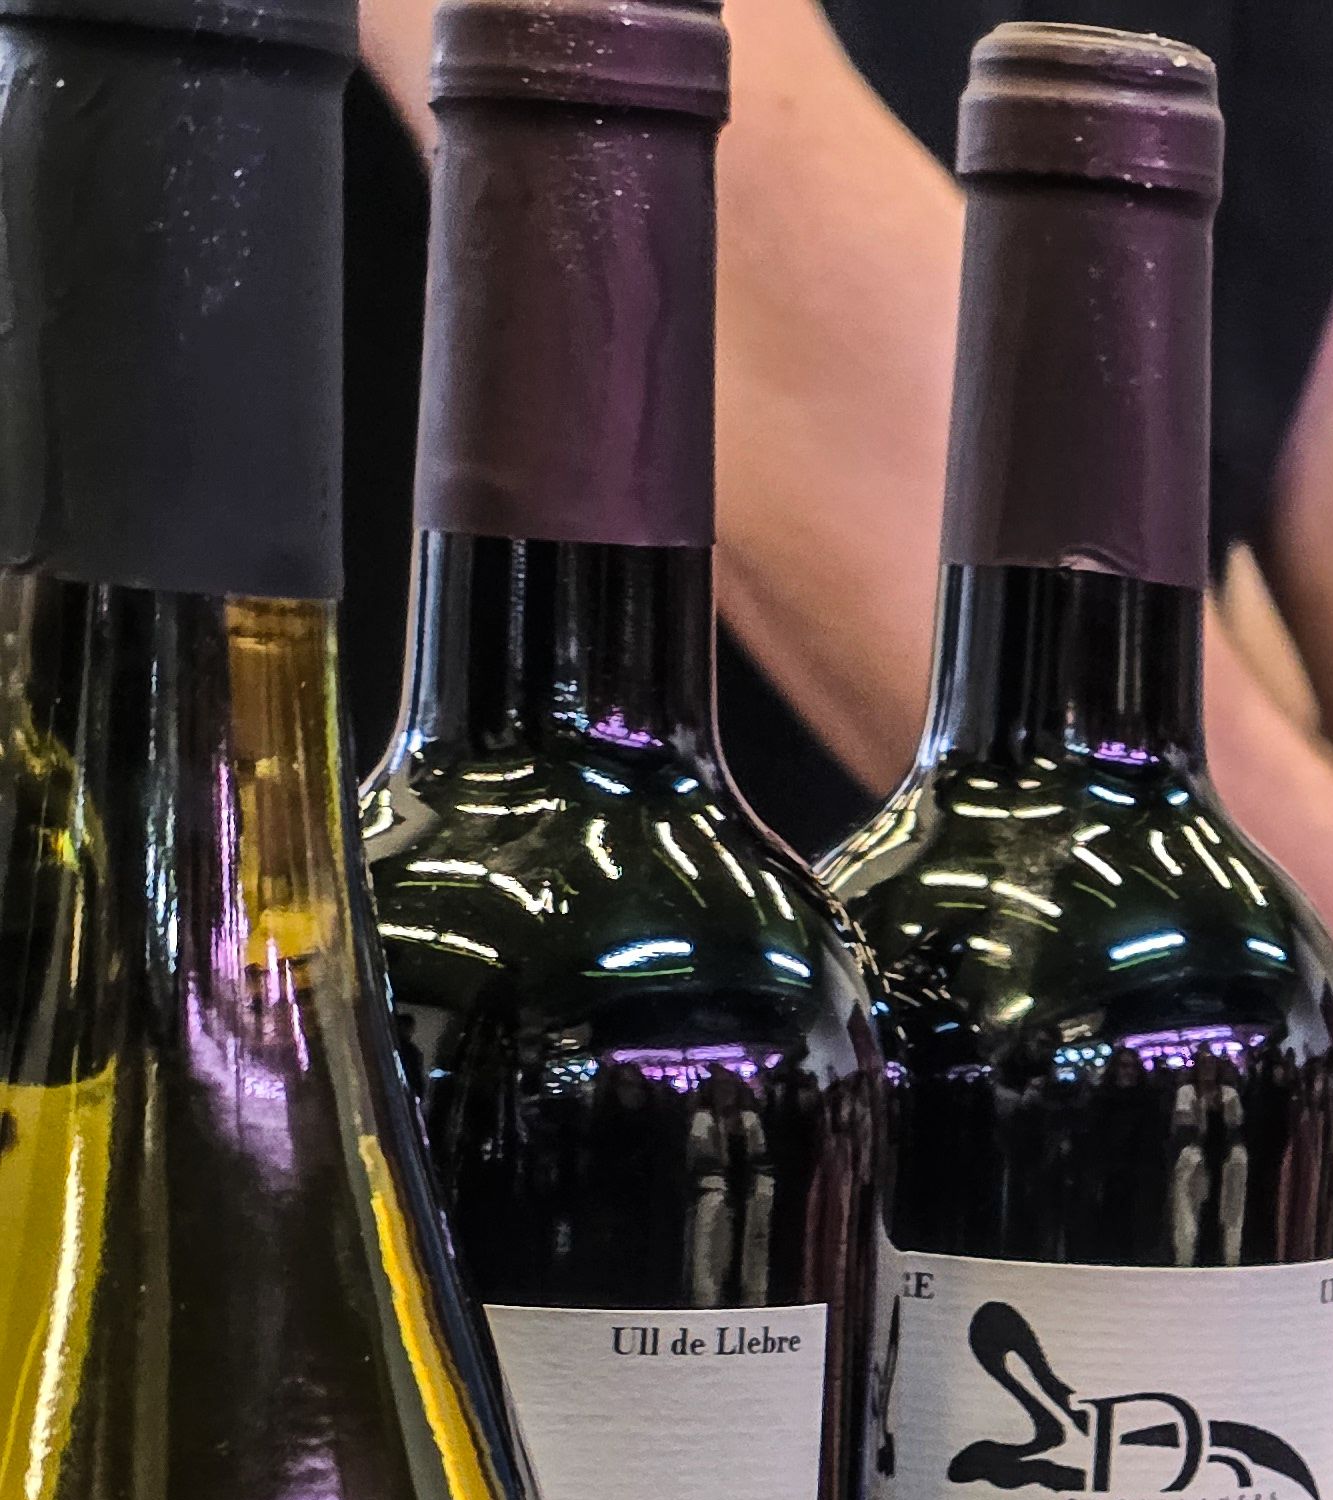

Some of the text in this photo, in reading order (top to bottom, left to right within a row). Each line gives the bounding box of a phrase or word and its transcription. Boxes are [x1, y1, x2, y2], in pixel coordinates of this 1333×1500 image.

[612, 1326, 801, 1356] Ull de Llebre
